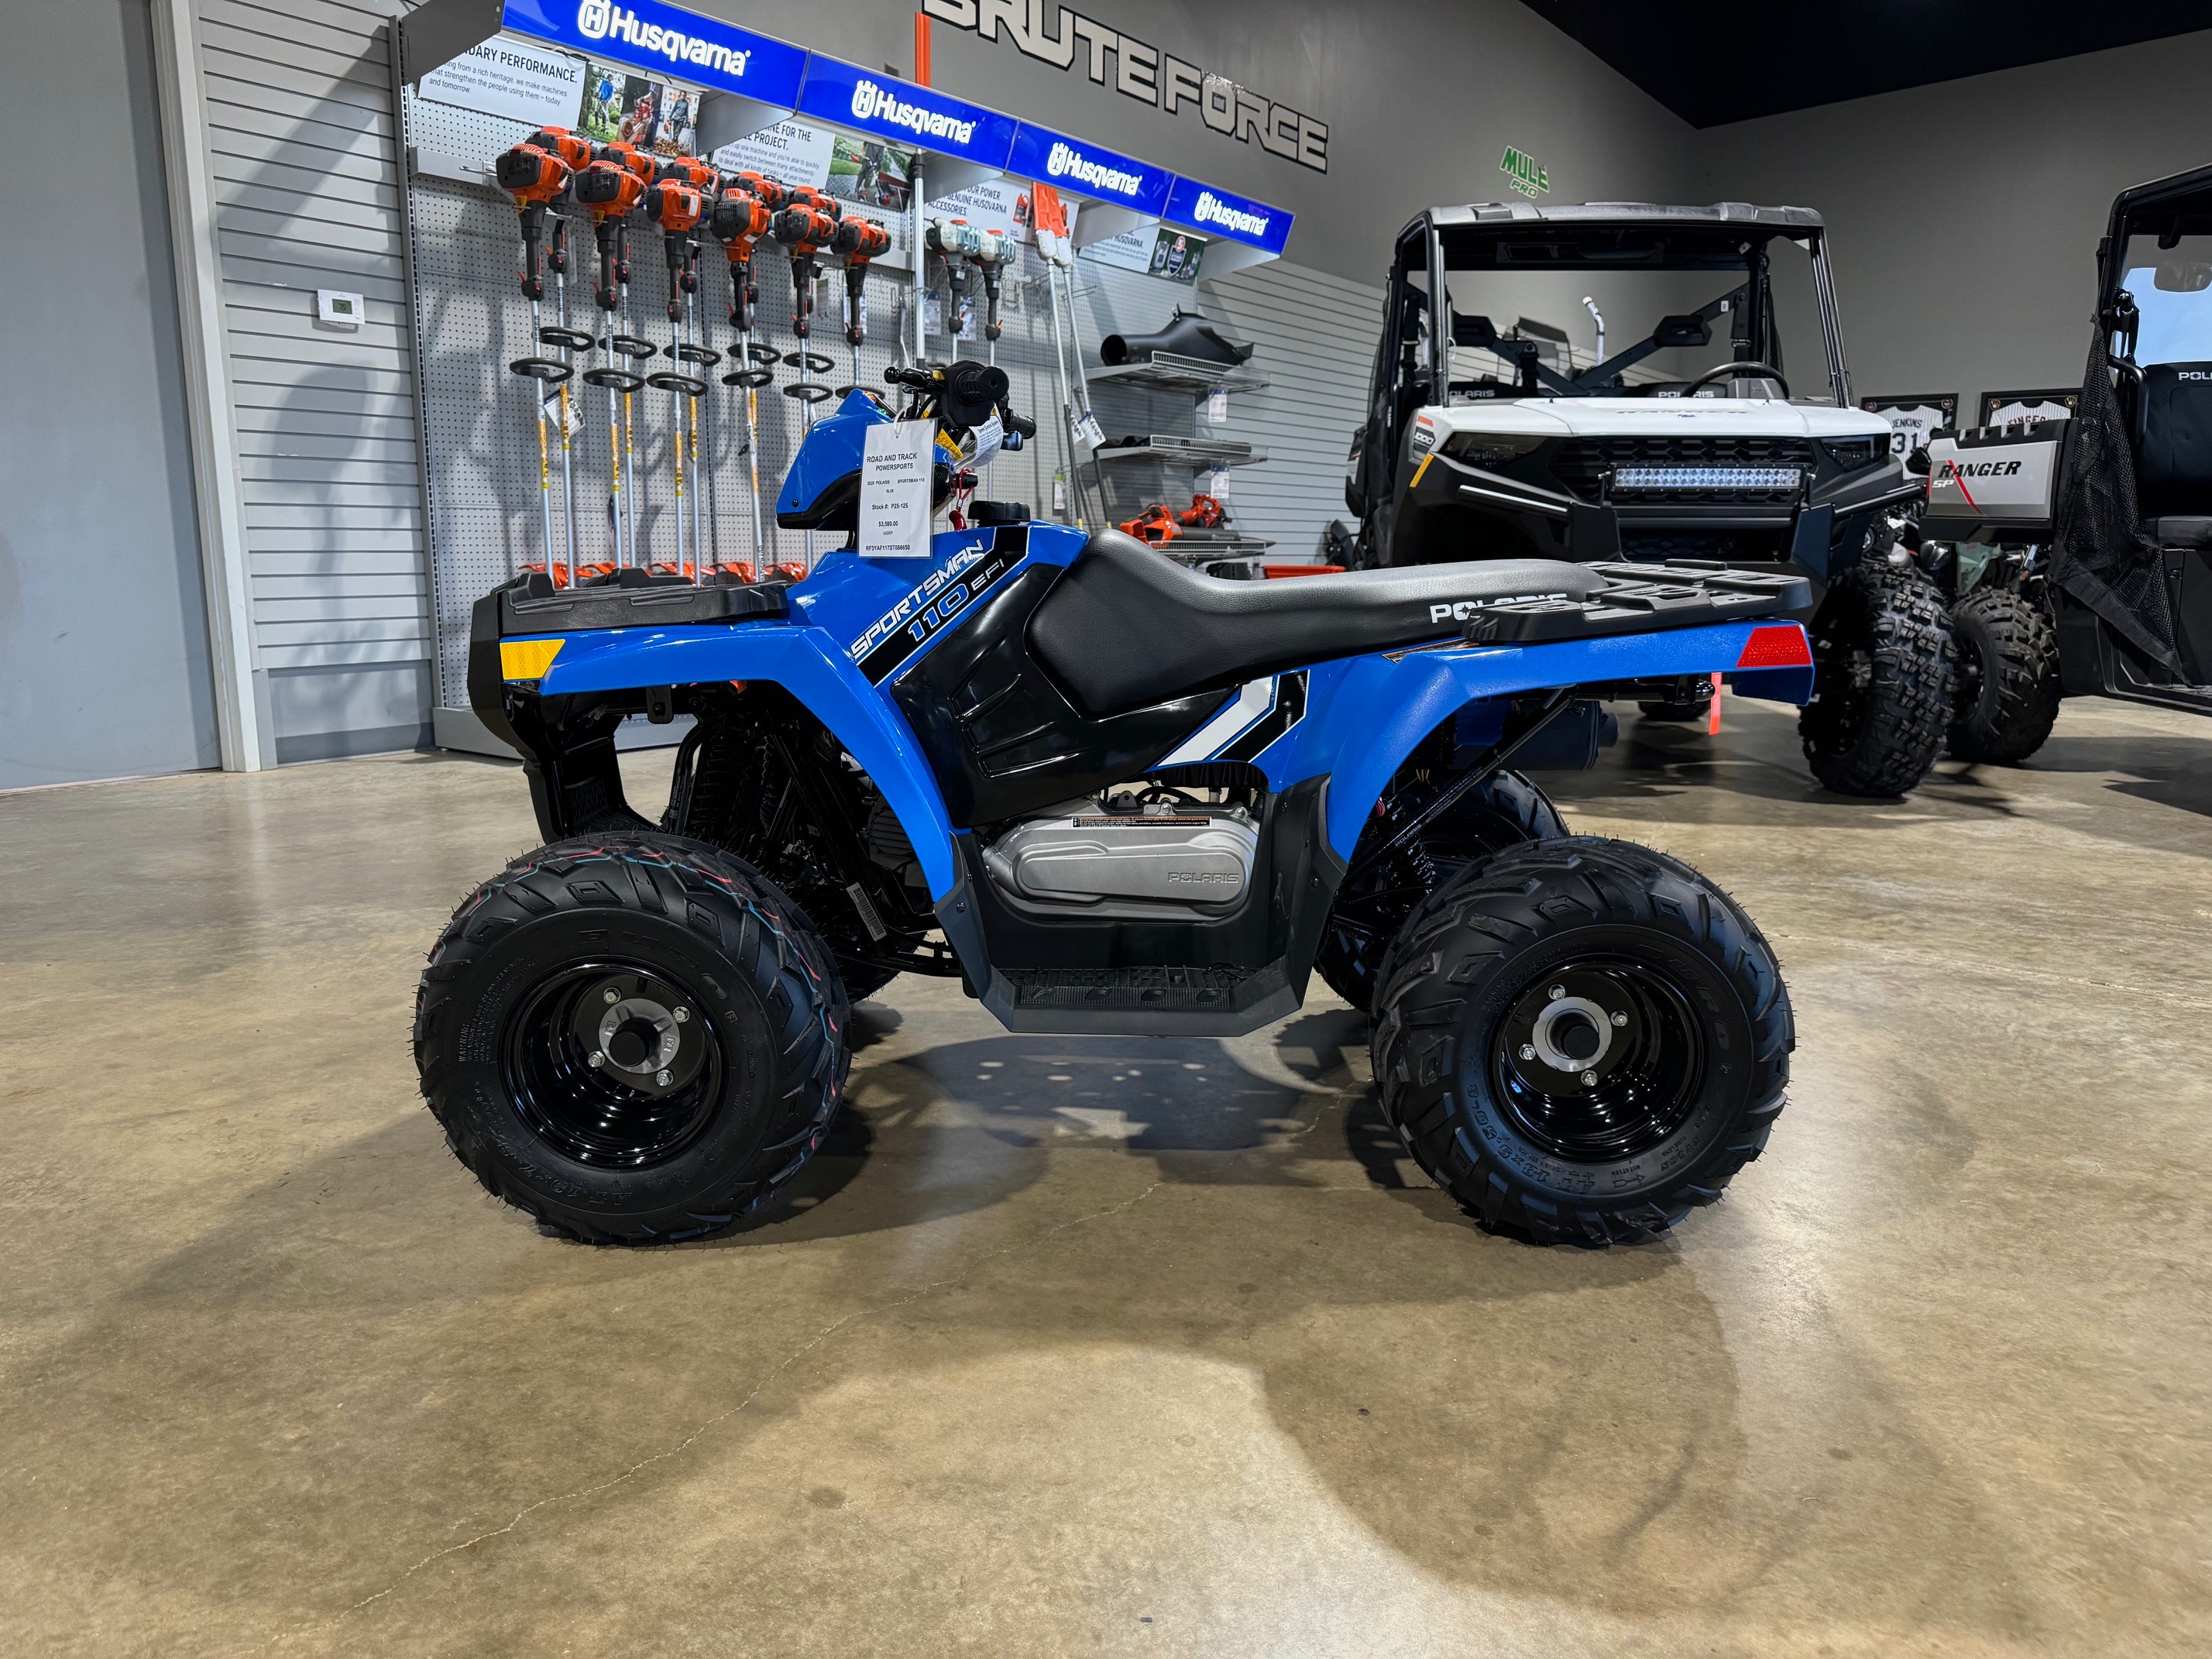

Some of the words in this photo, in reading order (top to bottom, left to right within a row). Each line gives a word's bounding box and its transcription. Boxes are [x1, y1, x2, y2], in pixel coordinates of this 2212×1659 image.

[610, 12, 746, 76] Husqvarna
[500, 51, 578, 84] PERFORMANCE.
[428, 77, 441, 86] and
[441, 81, 471, 94] tomorrow.
[444, 70, 476, 84] strengthen
[477, 79, 487, 88] the
[488, 82, 508, 92] people
[509, 87, 524, 98] using
[525, 90, 540, 101] them
[545, 94, 561, 107] today
[458, 62, 472, 72] from
[477, 68, 489, 77] rich
[525, 79, 541, 91] make
[541, 83, 567, 97] machines
[876, 92, 974, 145] Husqvarna
[1164, 53, 1328, 174] FORCE
[754, 132, 788, 150] PROJECT.
[781, 125, 795, 138] FOR
[798, 129, 812, 142] THE
[730, 151, 743, 160] easily
[757, 156, 776, 167] between
[776, 162, 788, 170] many
[788, 164, 814, 176] attachments
[750, 146, 768, 156] machine
[805, 160, 819, 170] quickly
[750, 163, 762, 172] kinds
[1499, 145, 1550, 194] MULE
[1063, 150, 1140, 196] Husqvarna
[981, 187, 1001, 201] POWER
[1510, 177, 1539, 199] PRO
[973, 198, 1007, 215] HUSQVARNA
[1209, 198, 1268, 236] Husqvarna
[1891, 419, 1922, 428] JENKINS
[875, 462, 914, 472] POWERSPORTS
[898, 452, 918, 461] TRACK
[1938, 461, 2021, 478] RANGER
[1932, 479, 1955, 488] SP
[850, 538, 985, 661] SPORTSMAN
[908, 583, 969, 642] 110
[970, 558, 1005, 592] EFI
[1395, 823, 1423, 847] POLARIS
[1168, 871, 1238, 884] POLARIS
[1610, 1163, 1641, 1176] ROTATION
